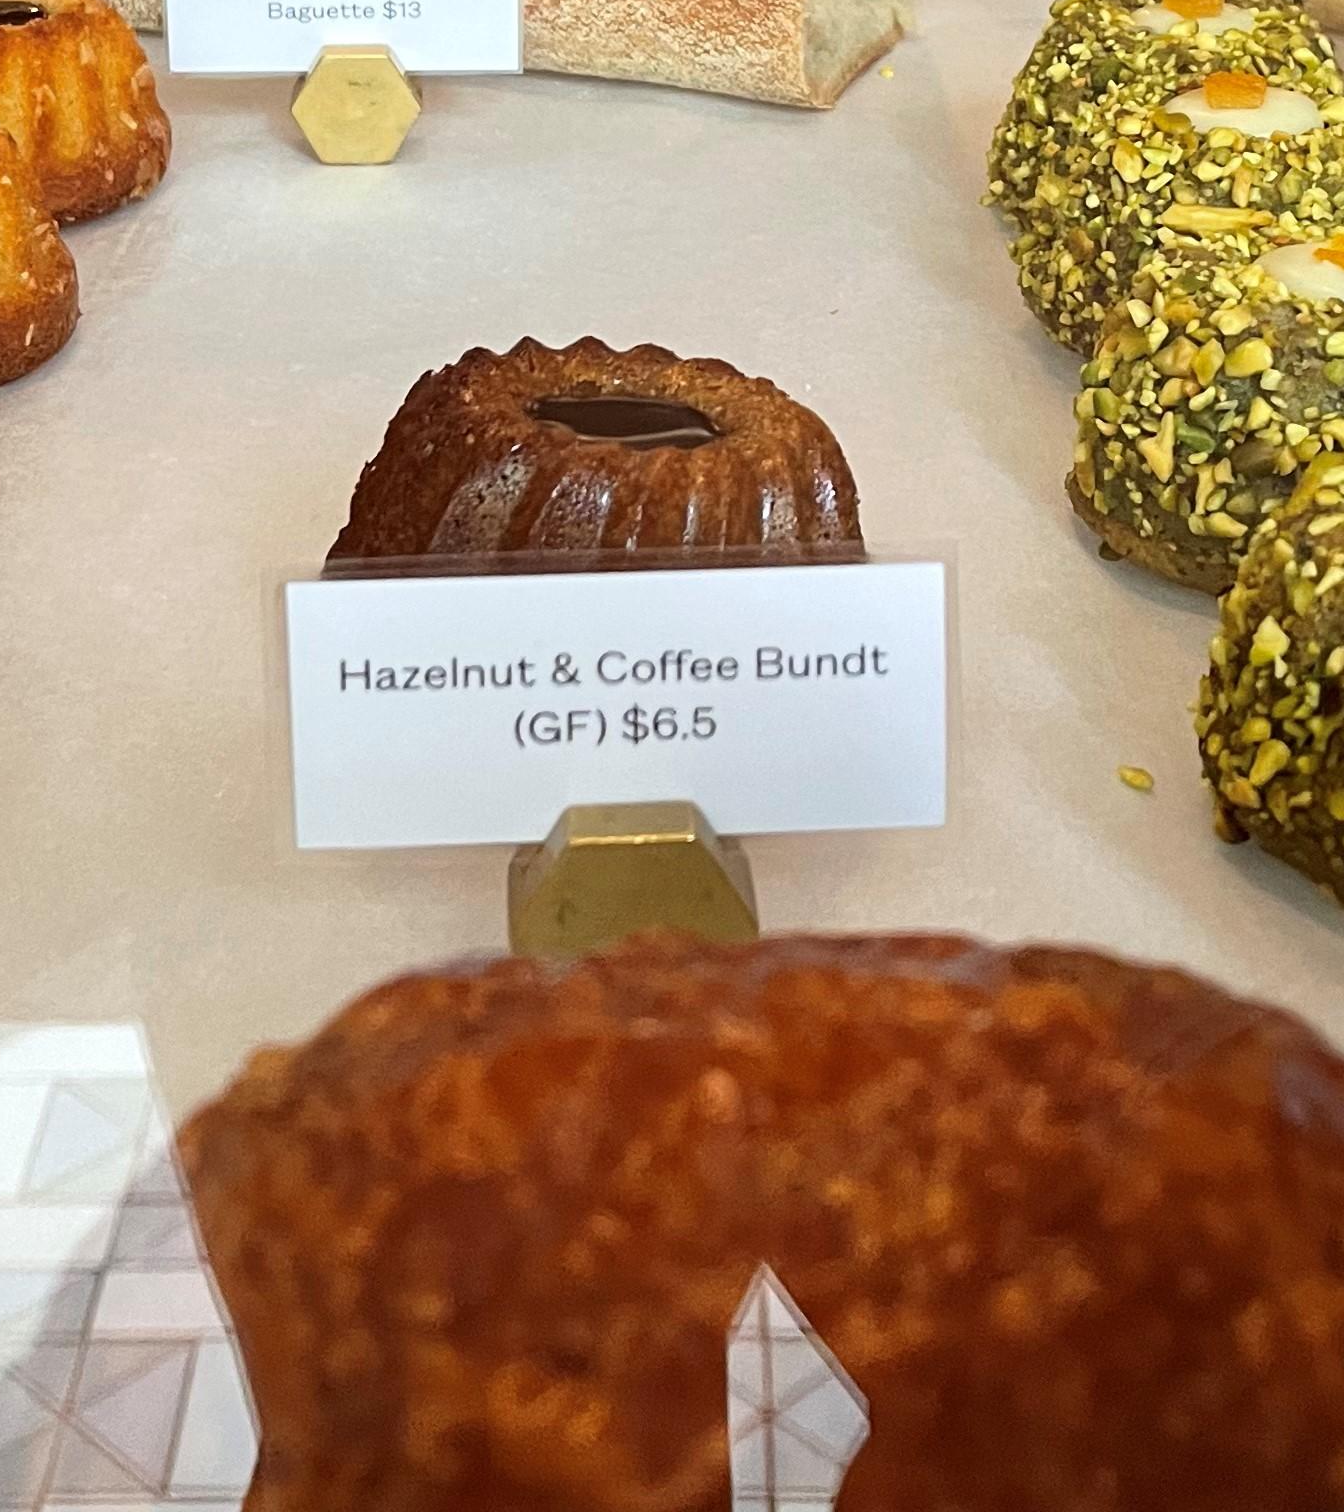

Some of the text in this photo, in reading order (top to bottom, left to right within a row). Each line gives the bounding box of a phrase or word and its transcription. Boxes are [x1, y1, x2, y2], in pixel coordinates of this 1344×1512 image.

[267, 0, 422, 24] Baguette $13
[339, 643, 890, 691] Hazelnut & Coffee Bundt
[513, 702, 718, 749] (GF) $6.5
